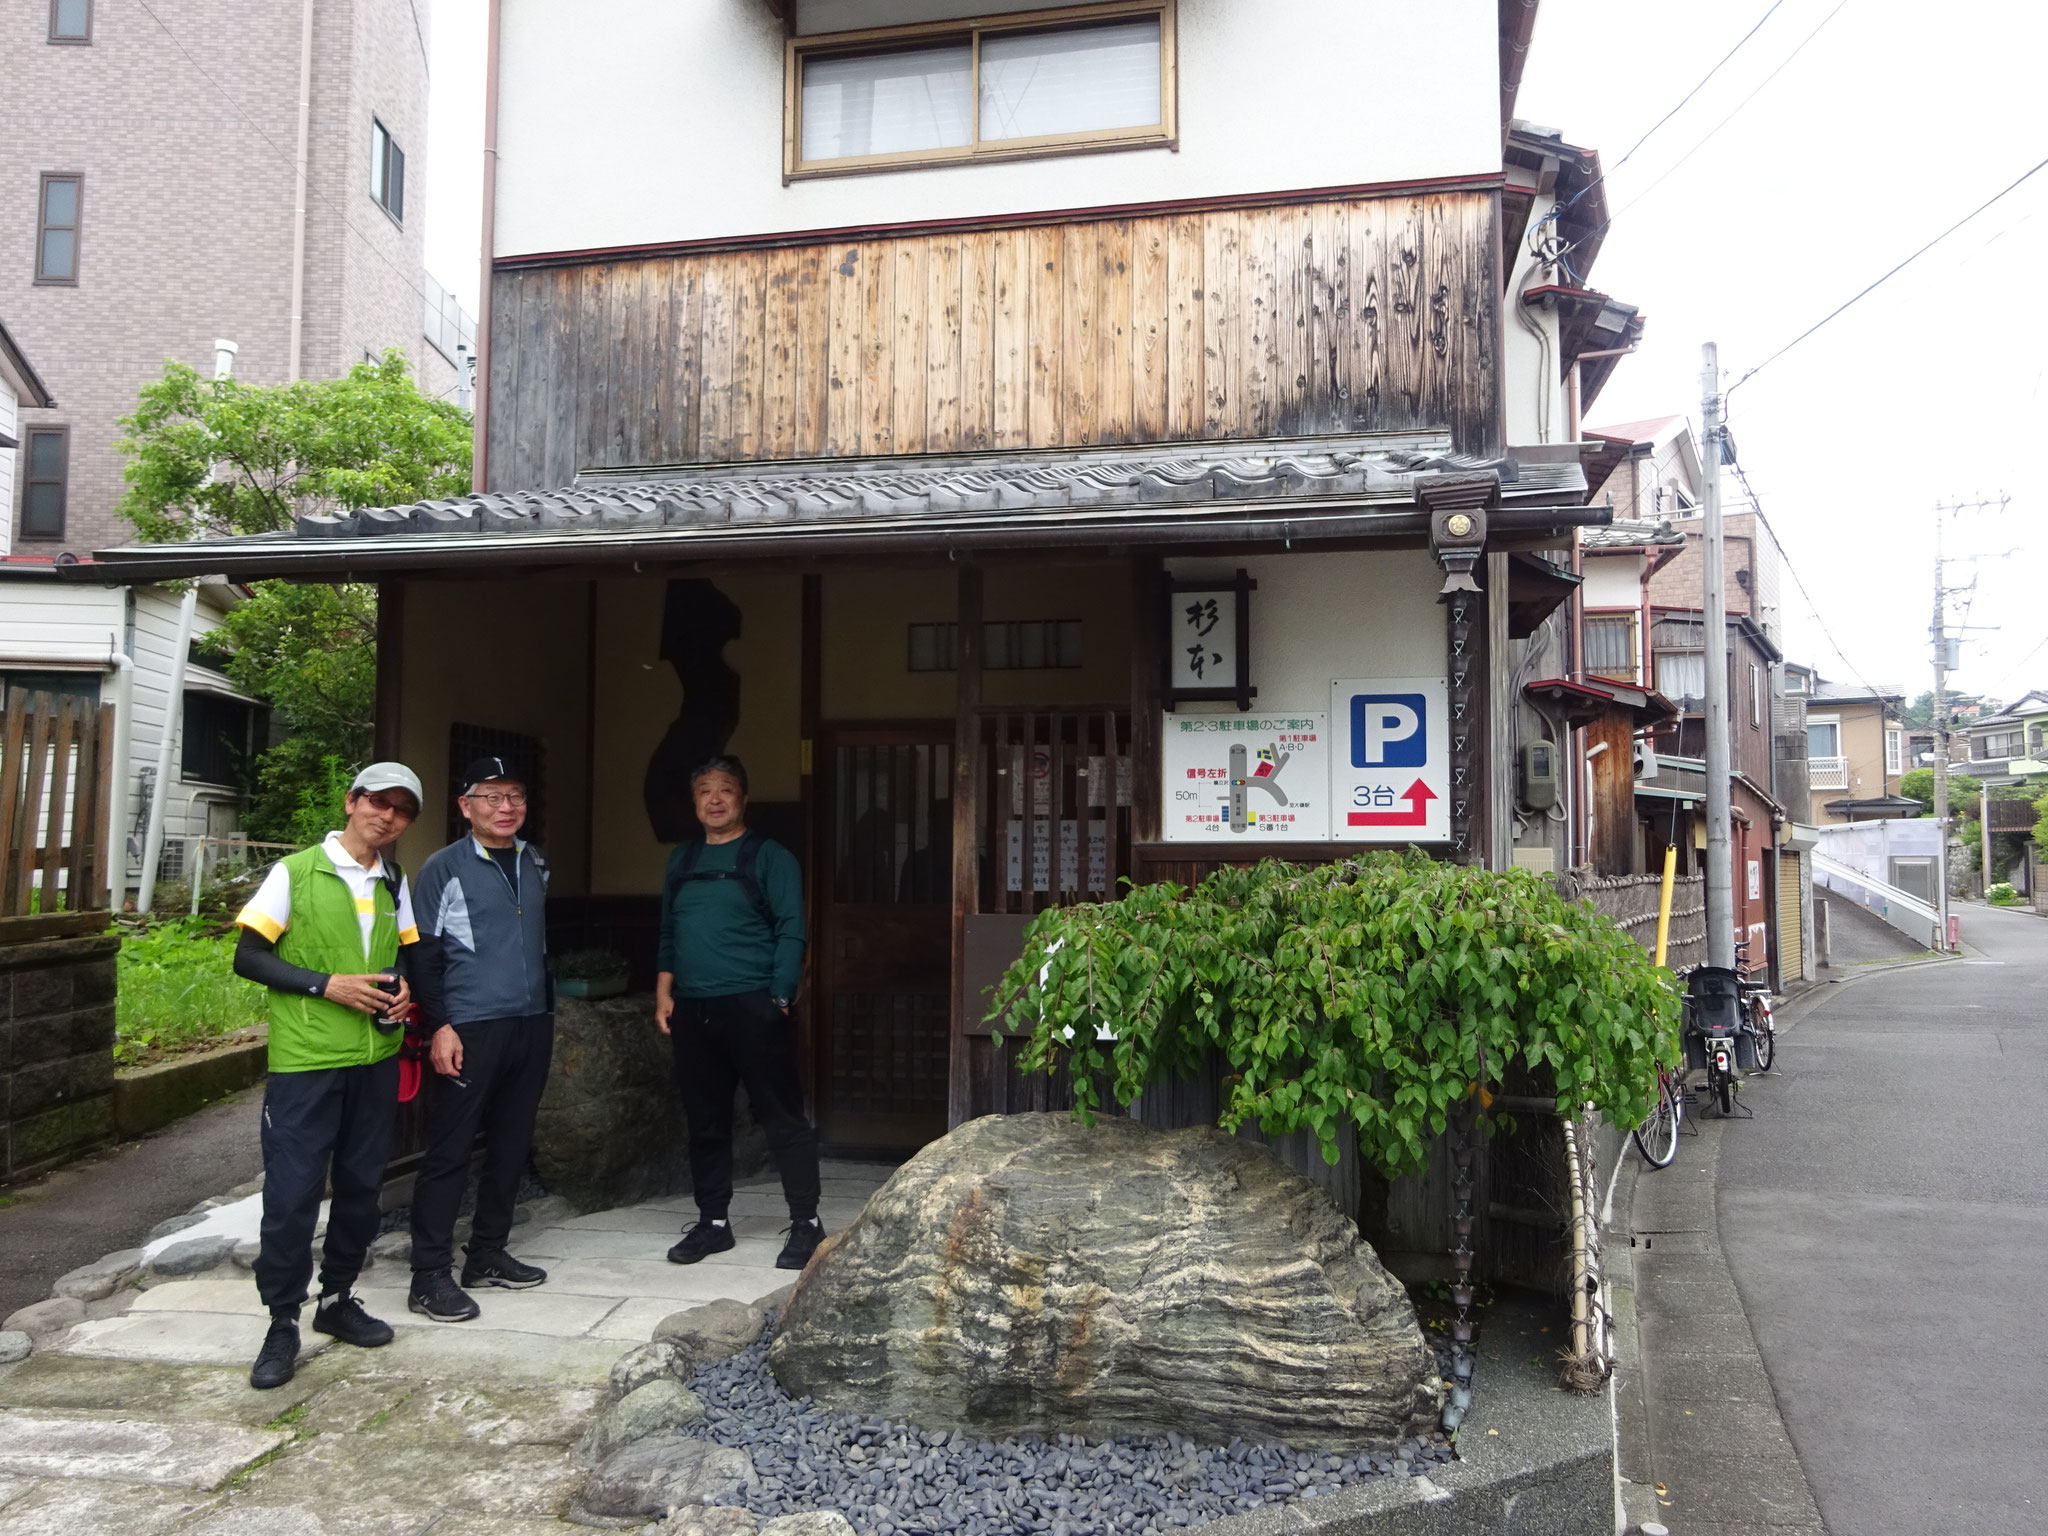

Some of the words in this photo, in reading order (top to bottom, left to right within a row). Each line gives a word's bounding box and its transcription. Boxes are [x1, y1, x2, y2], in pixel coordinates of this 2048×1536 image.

[1365, 703, 1418, 762] P
[1186, 768, 1228, 779] 信号左折
[1175, 791, 1198, 800] 50m
[1353, 785, 1395, 807] 3台
[1205, 824, 1220, 832] 4台
